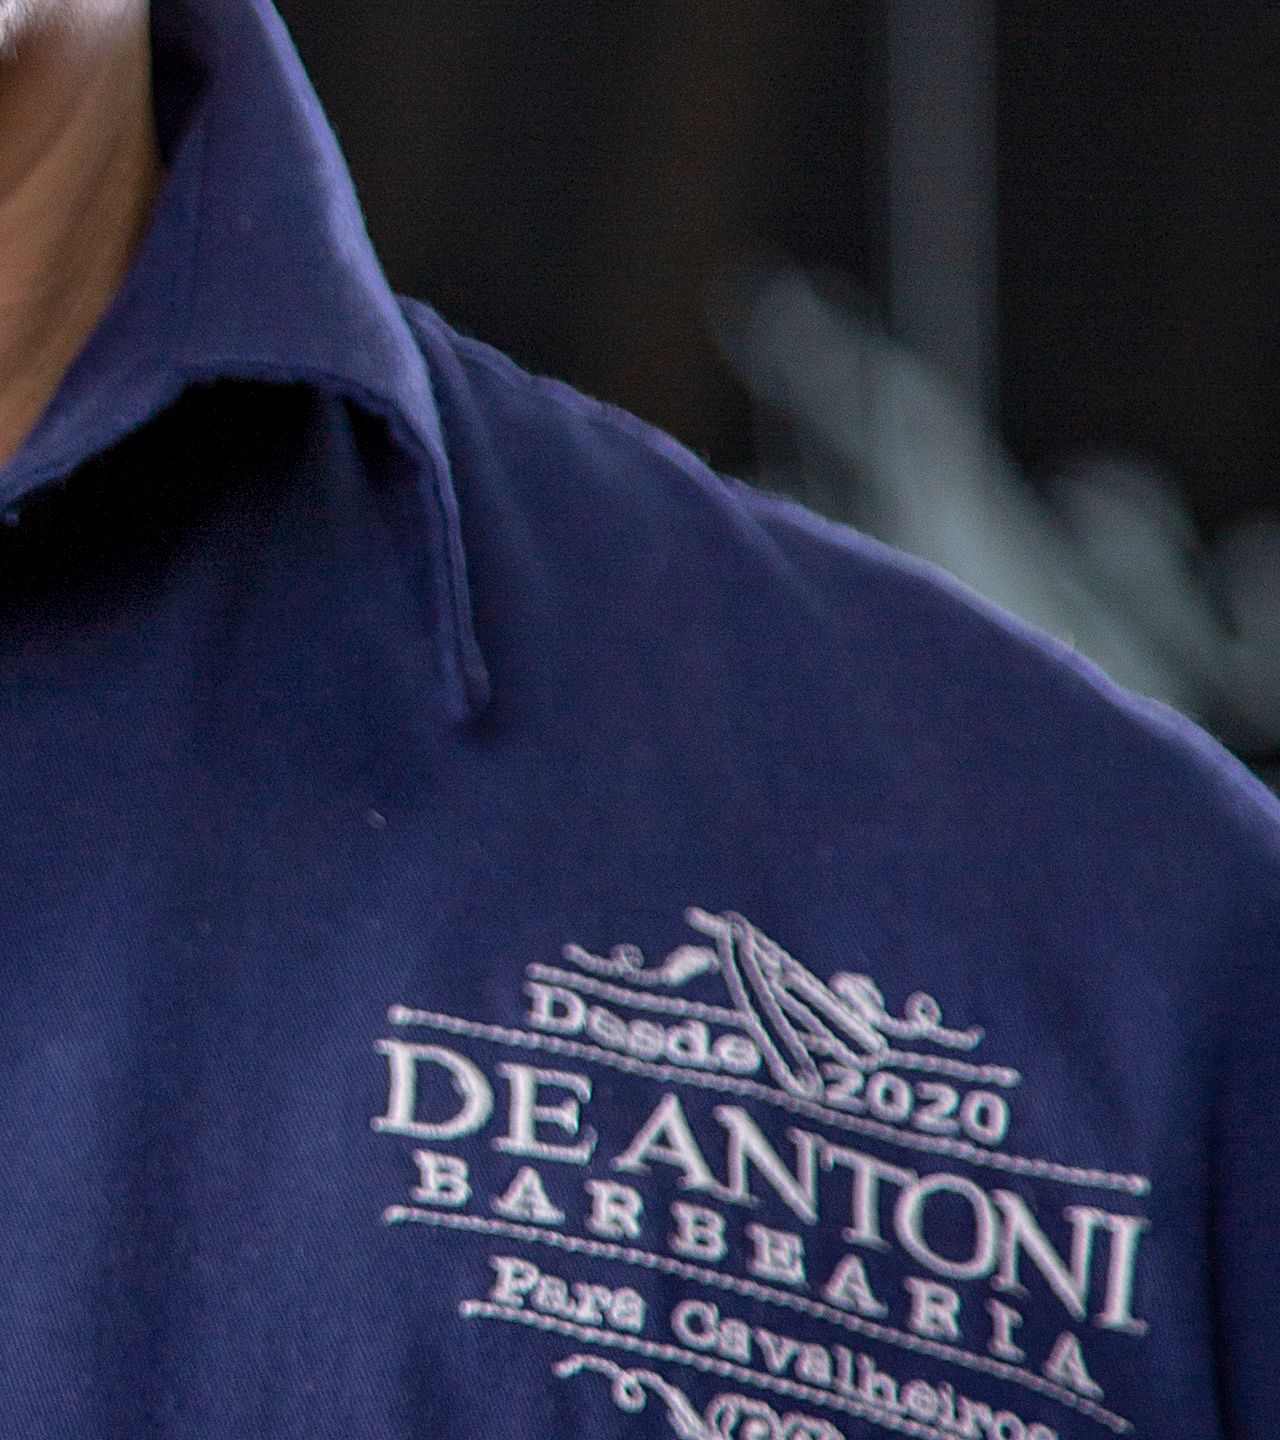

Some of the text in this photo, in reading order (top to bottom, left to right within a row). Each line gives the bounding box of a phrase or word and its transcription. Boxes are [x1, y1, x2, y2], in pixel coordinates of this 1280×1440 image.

[527, 982, 1010, 1146] Desde 2020
[372, 1038, 1149, 1337] DE ANTONI
[414, 1150, 1103, 1401] BARBEARIA
[490, 1256, 647, 1333] Para
